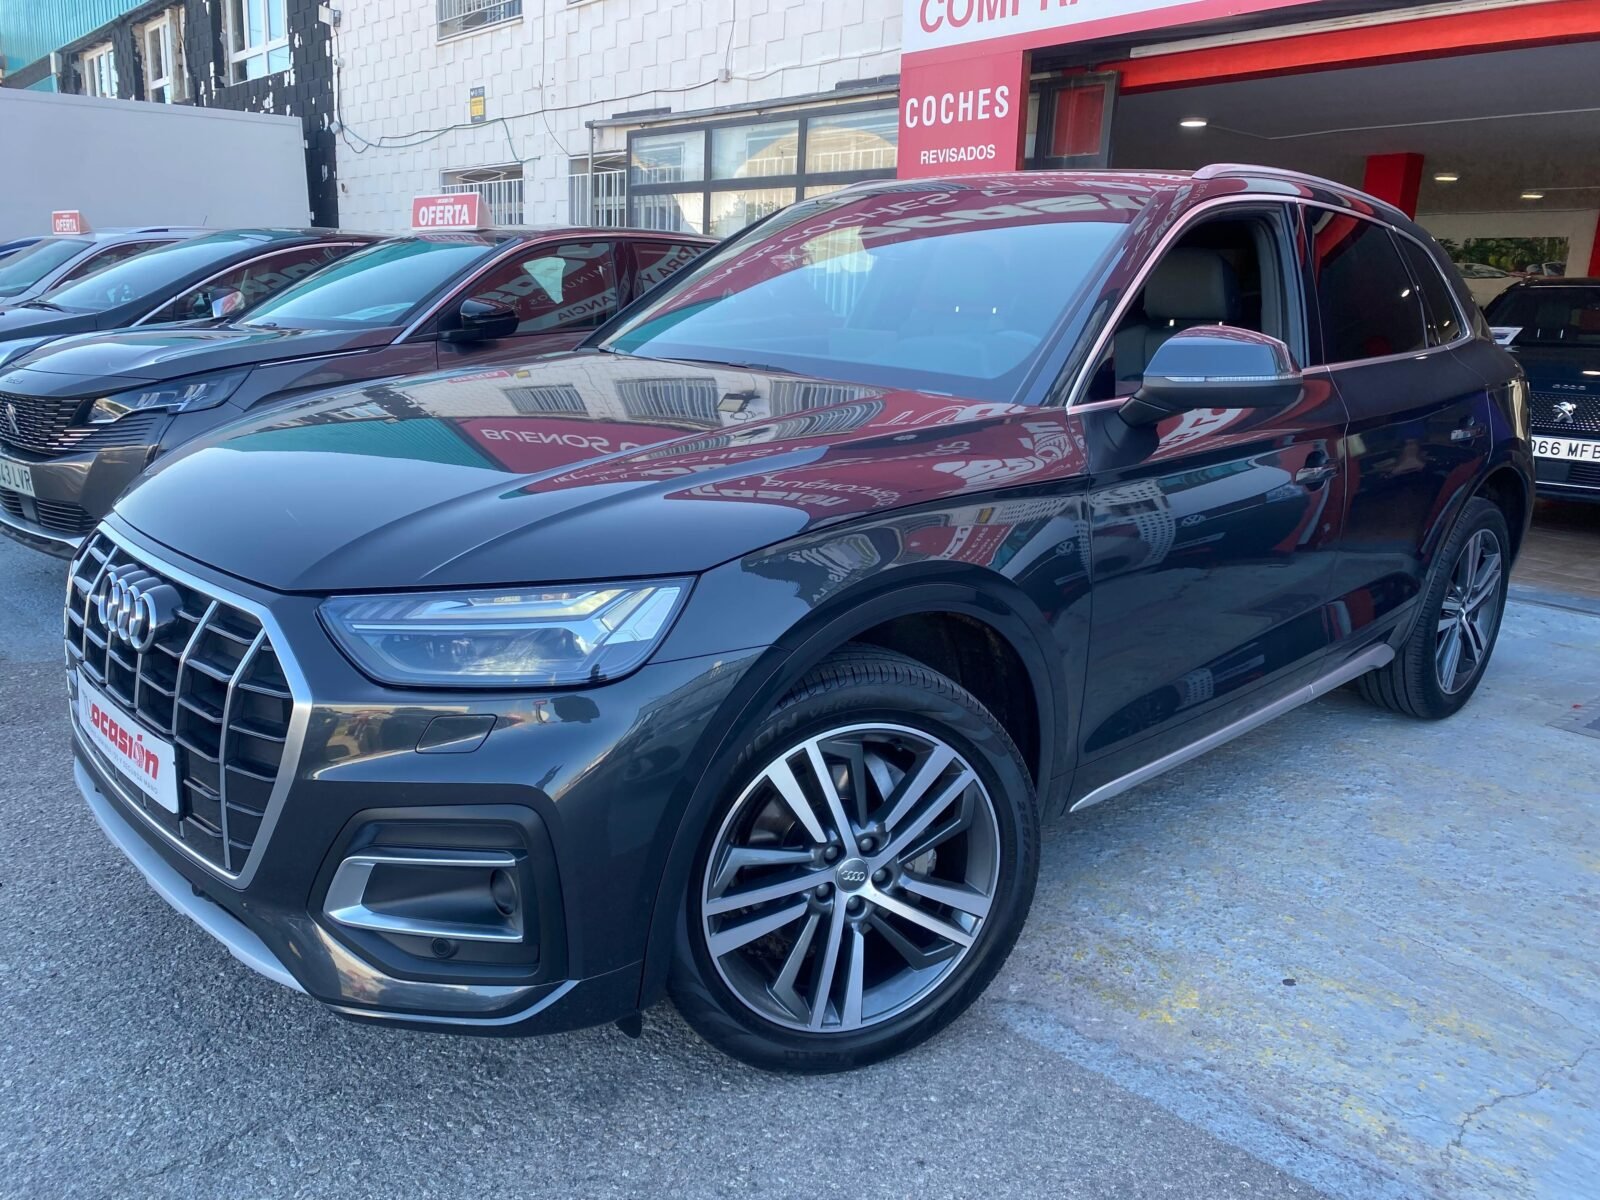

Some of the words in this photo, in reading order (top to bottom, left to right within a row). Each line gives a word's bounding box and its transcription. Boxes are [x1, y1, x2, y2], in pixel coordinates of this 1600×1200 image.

[920, 0, 1079, 33] COM
[905, 86, 1009, 128] COCHES
[920, 144, 996, 165] REVISADOS
[418, 204, 470, 226] OFERTA
[0, 463, 11, 486] 43
[12, 466, 32, 492] LVR
